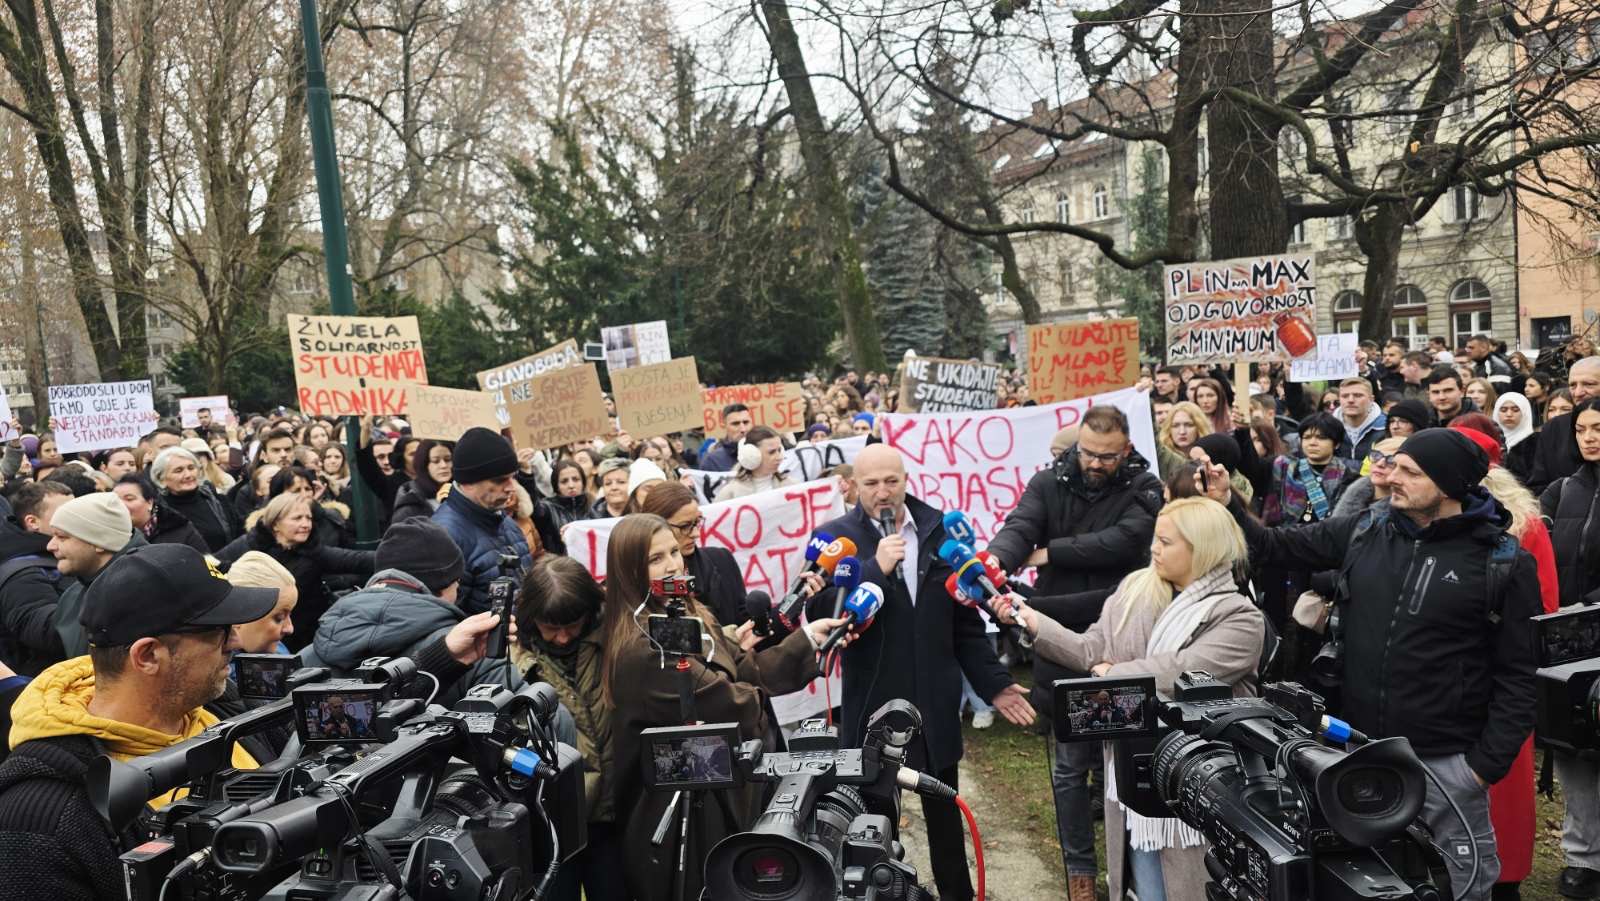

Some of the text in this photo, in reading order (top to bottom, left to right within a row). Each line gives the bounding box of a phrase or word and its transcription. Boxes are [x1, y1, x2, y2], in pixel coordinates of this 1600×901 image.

[1252, 259, 1310, 287] MAX
[1169, 286, 1316, 323] ODGOVORNOST
[298, 316, 401, 337] ŽIVJELA
[300, 338, 418, 353] SOLIDARNOST
[299, 350, 424, 380] STUDENATA
[1032, 347, 1126, 372] U MLADE
[621, 367, 669, 388] DOSTA
[906, 360, 1000, 390] NE UKIDAJTE
[118, 384, 127, 397] U
[130, 383, 150, 393] DOM
[299, 387, 409, 415] RADNIKA
[511, 383, 533, 402] NE
[50, 400, 84, 417] TAMO
[123, 398, 138, 410] JE
[773, 397, 801, 428] SE
[54, 412, 117, 432] NEPRAVDA
[881, 415, 1014, 465] KAKO
